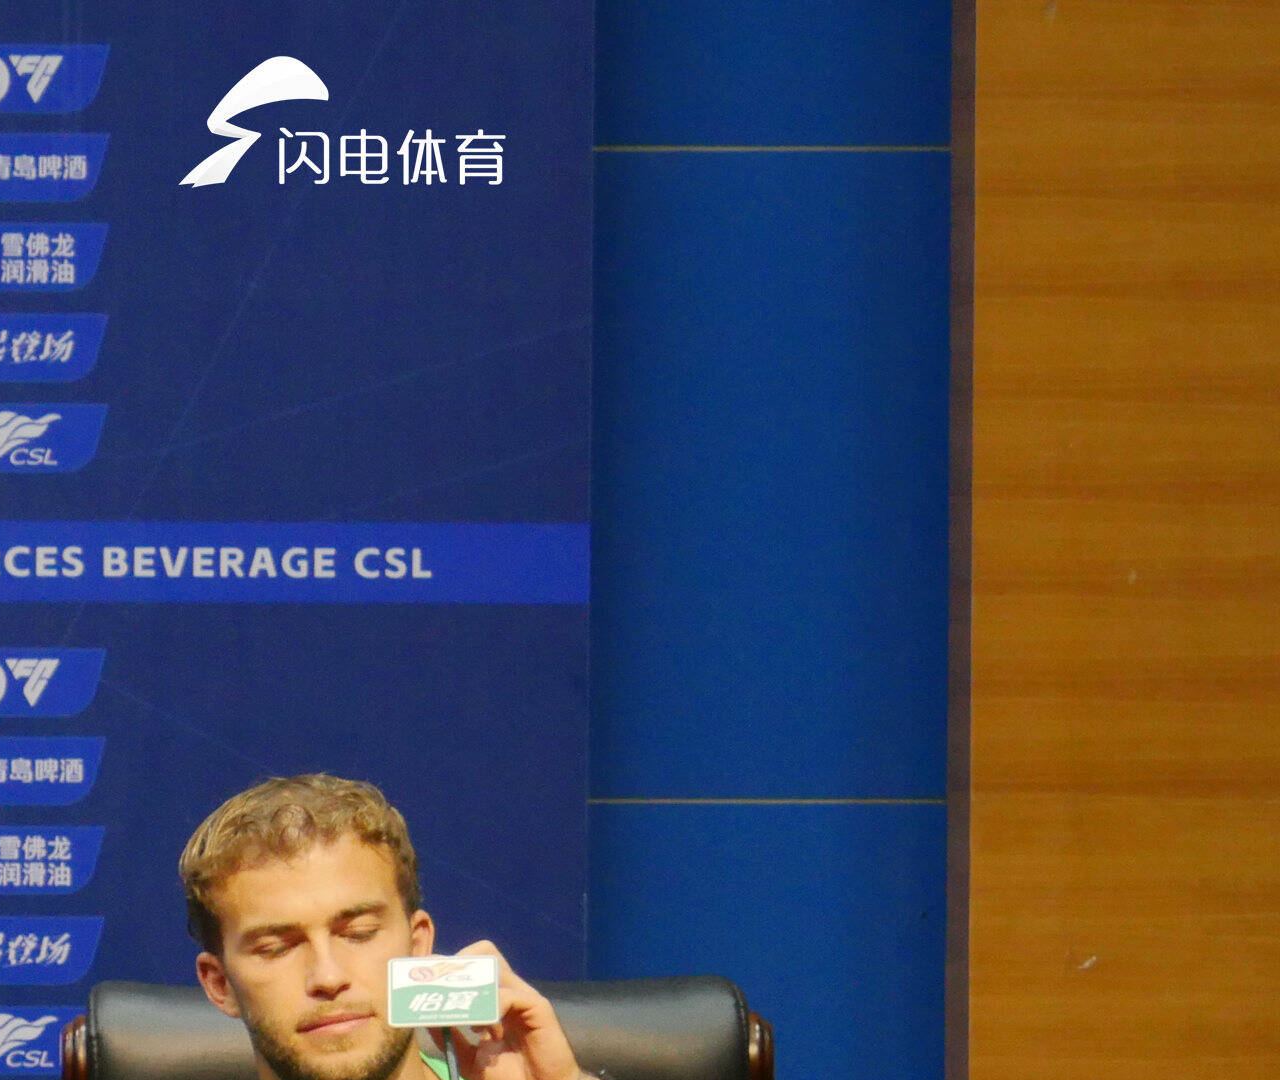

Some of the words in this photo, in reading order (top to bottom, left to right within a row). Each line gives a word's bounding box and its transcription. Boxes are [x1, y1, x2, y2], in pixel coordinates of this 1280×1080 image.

[1, 232, 76, 257] 雪佛龙
[1, 259, 76, 284] 润滑油
[10, 448, 57, 466] CSL
[103, 547, 337, 578] BEVERAGE
[354, 548, 433, 579] CSL
[6, 1050, 53, 1068] CSL
